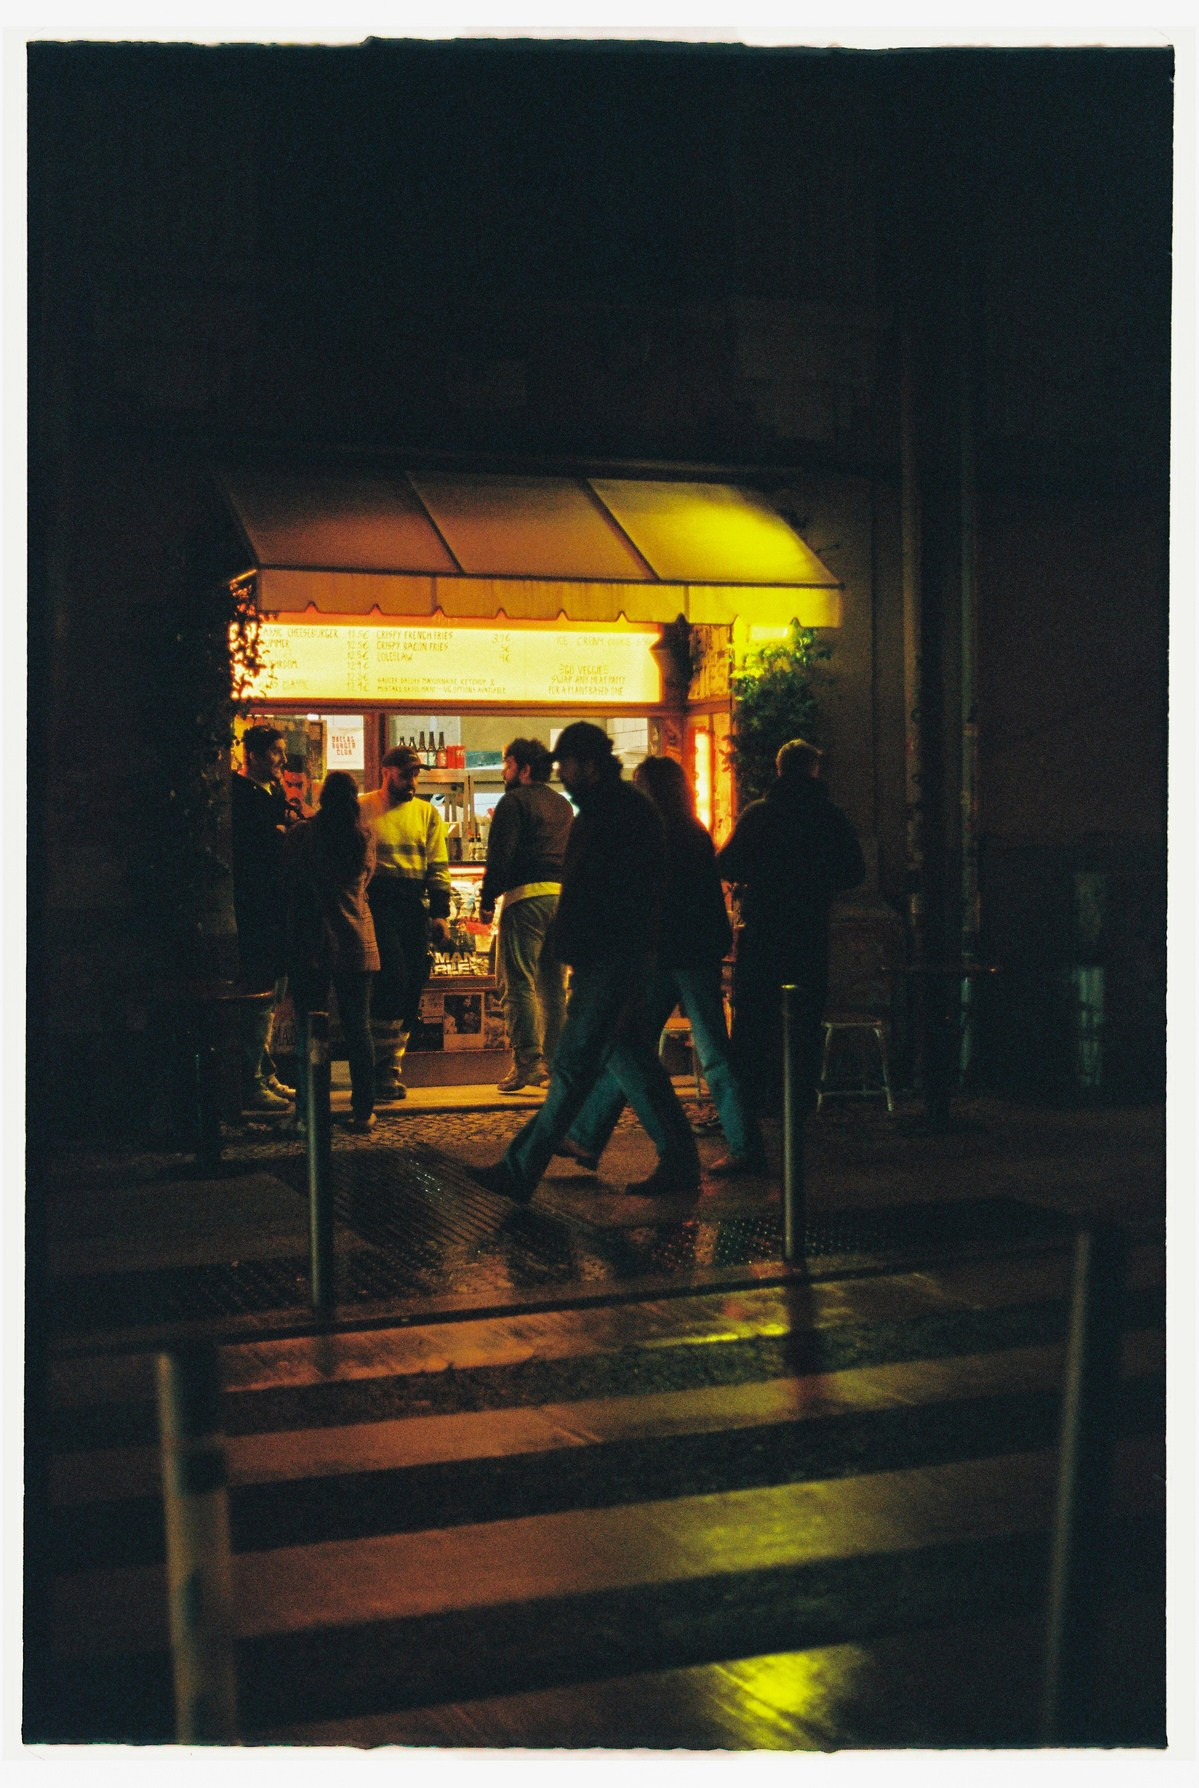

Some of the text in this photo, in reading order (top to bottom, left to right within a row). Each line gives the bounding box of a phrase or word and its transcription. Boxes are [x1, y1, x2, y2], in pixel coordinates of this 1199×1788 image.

[287, 627, 338, 640] CHEESEBURGER
[377, 629, 453, 641] CRISPY FRENCH FRIES
[377, 640, 449, 652] CRISPY BACON FRIES
[377, 651, 413, 662] COLESLAW
[548, 685, 561, 695] FOR
